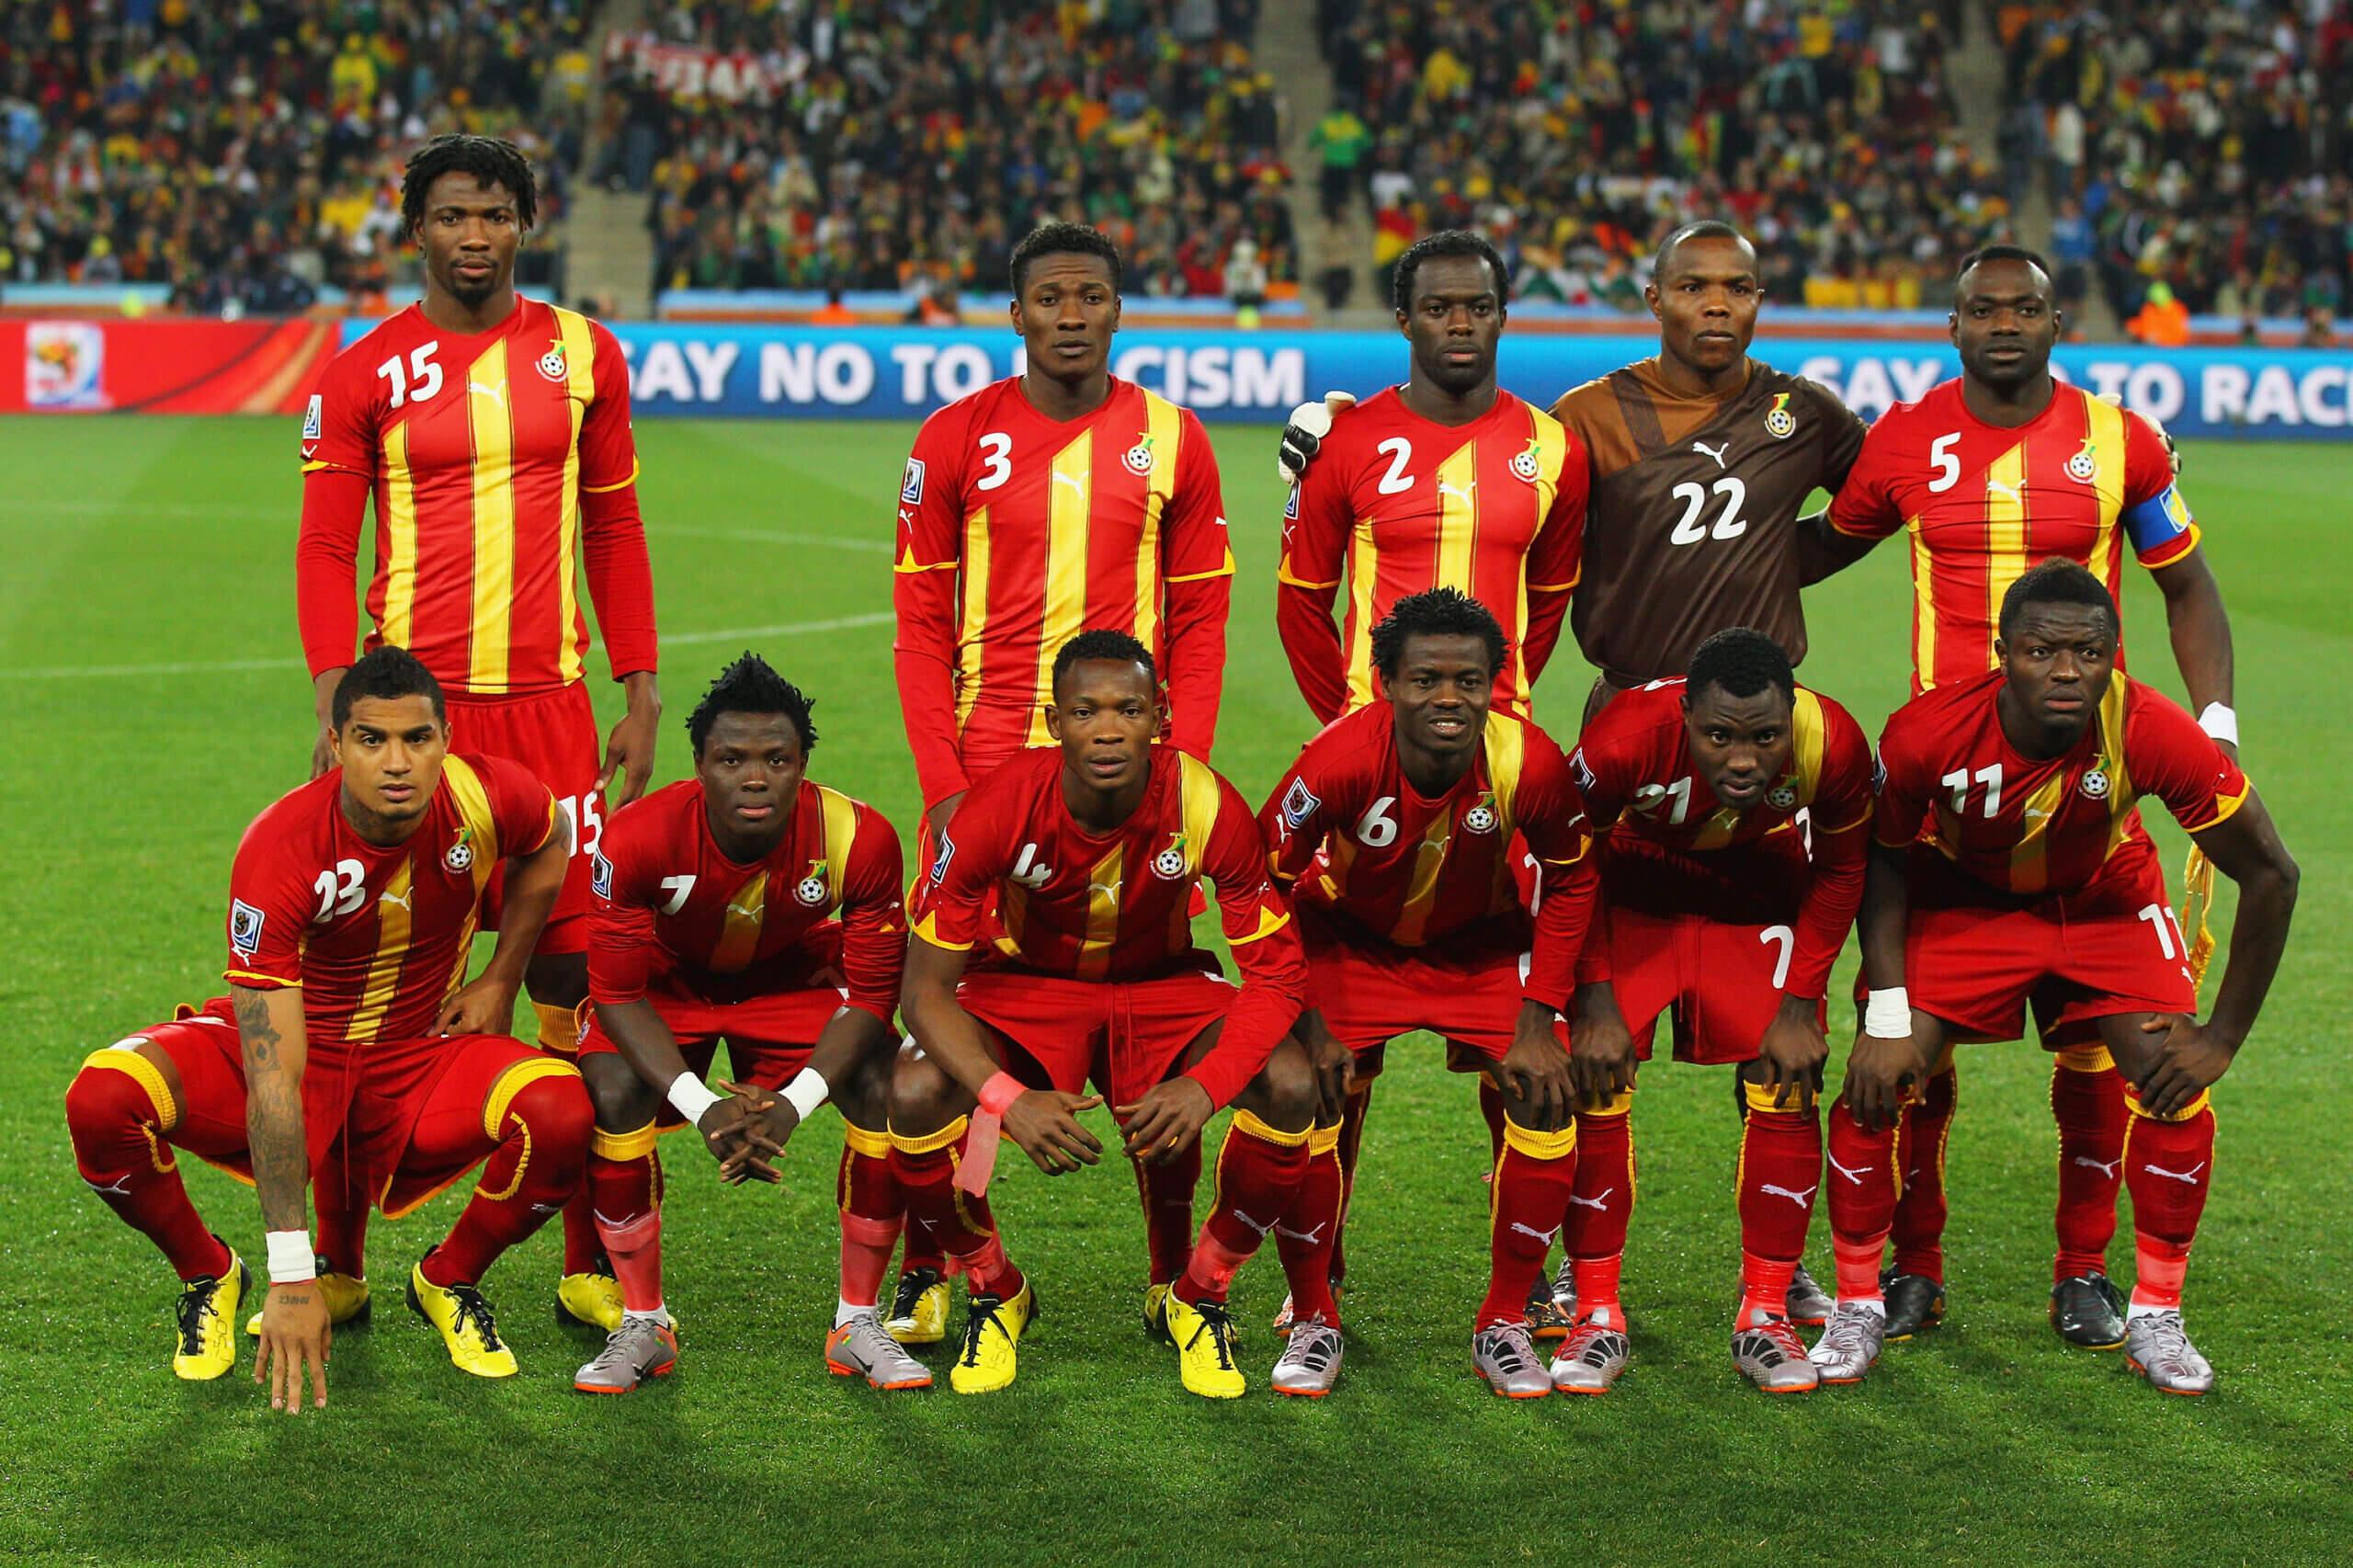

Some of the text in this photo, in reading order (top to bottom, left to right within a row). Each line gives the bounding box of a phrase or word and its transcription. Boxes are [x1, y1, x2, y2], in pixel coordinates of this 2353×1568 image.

[377, 339, 443, 409] 15
[620, 341, 1305, 409] AY NO TO CISM
[2085, 361, 2185, 423] TO
[977, 432, 1012, 491] 3
[1377, 437, 1415, 494] 2
[1927, 431, 1961, 493] 5
[1669, 476, 1746, 545] 22
[1940, 763, 2003, 819] 11
[1356, 796, 1398, 847] 6
[313, 858, 367, 924] 23
[660, 874, 698, 915] 7
[1010, 842, 1052, 890] 4
